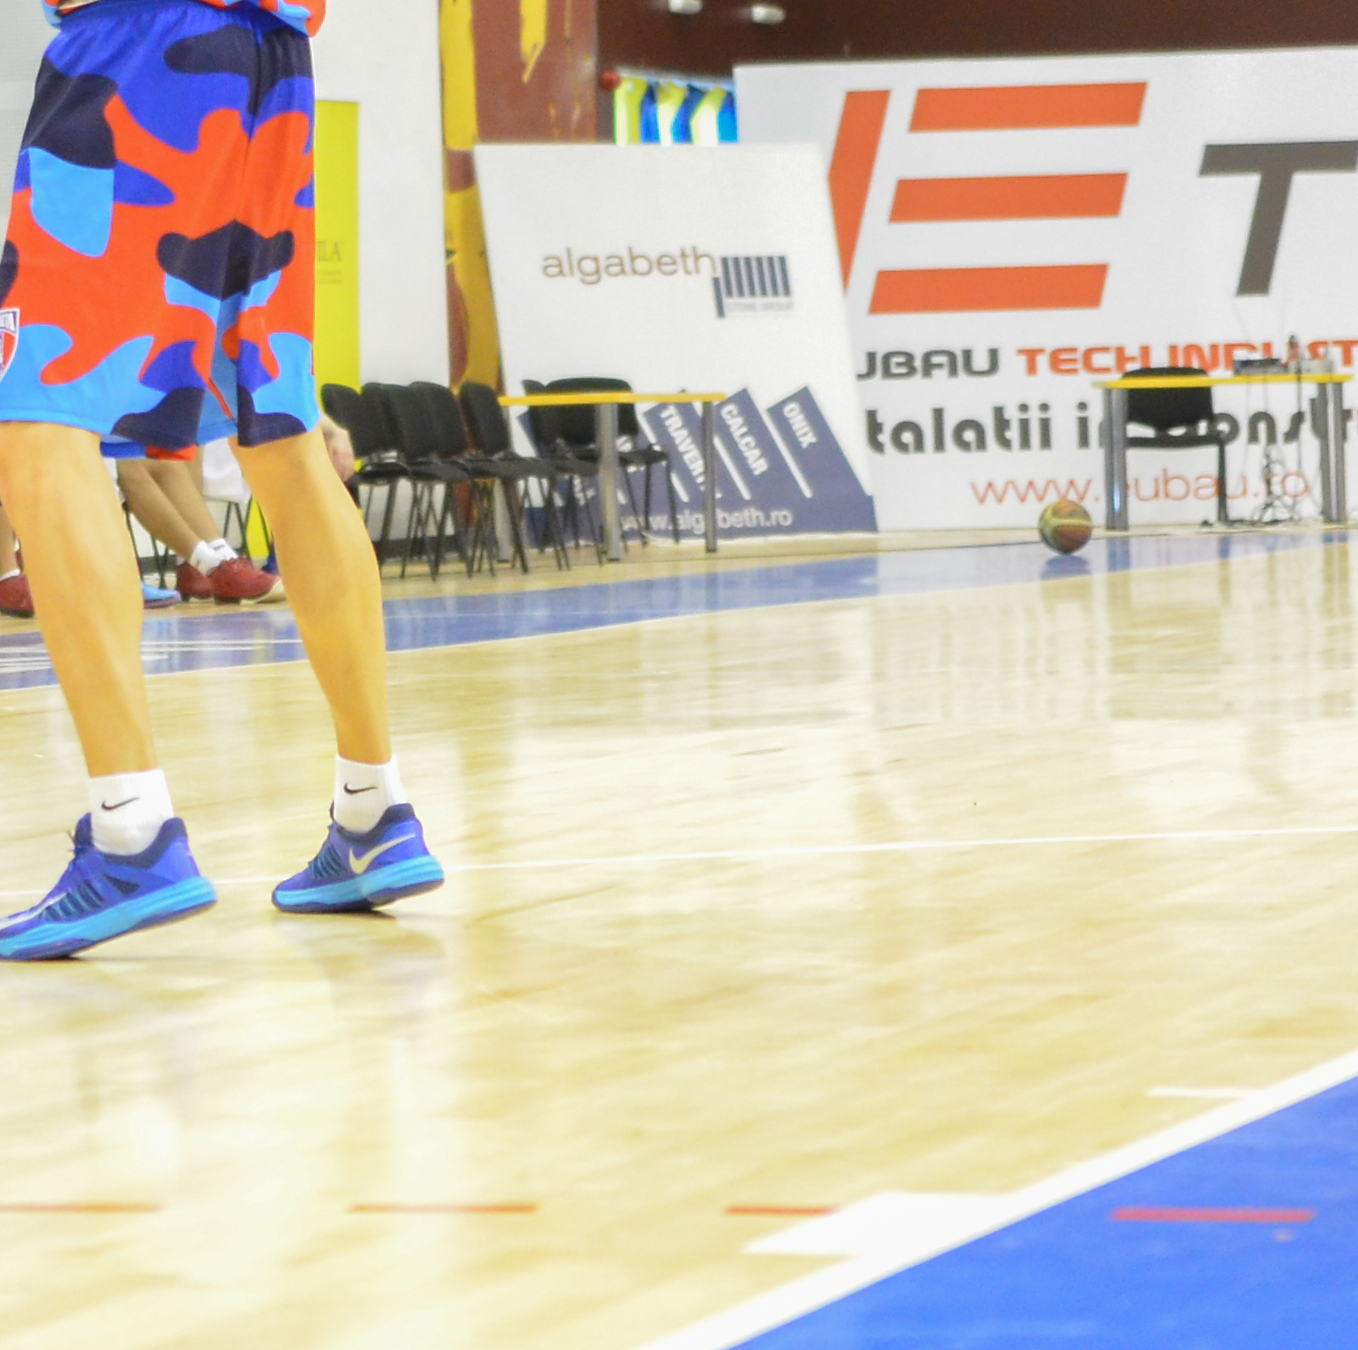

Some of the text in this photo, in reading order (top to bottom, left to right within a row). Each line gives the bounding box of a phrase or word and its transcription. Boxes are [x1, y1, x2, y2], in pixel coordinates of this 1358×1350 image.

[542, 246, 717, 285] algabeth
[1017, 344, 1152, 376] TECH
[720, 402, 769, 476] CALCAR
[783, 401, 818, 449] ONIX
